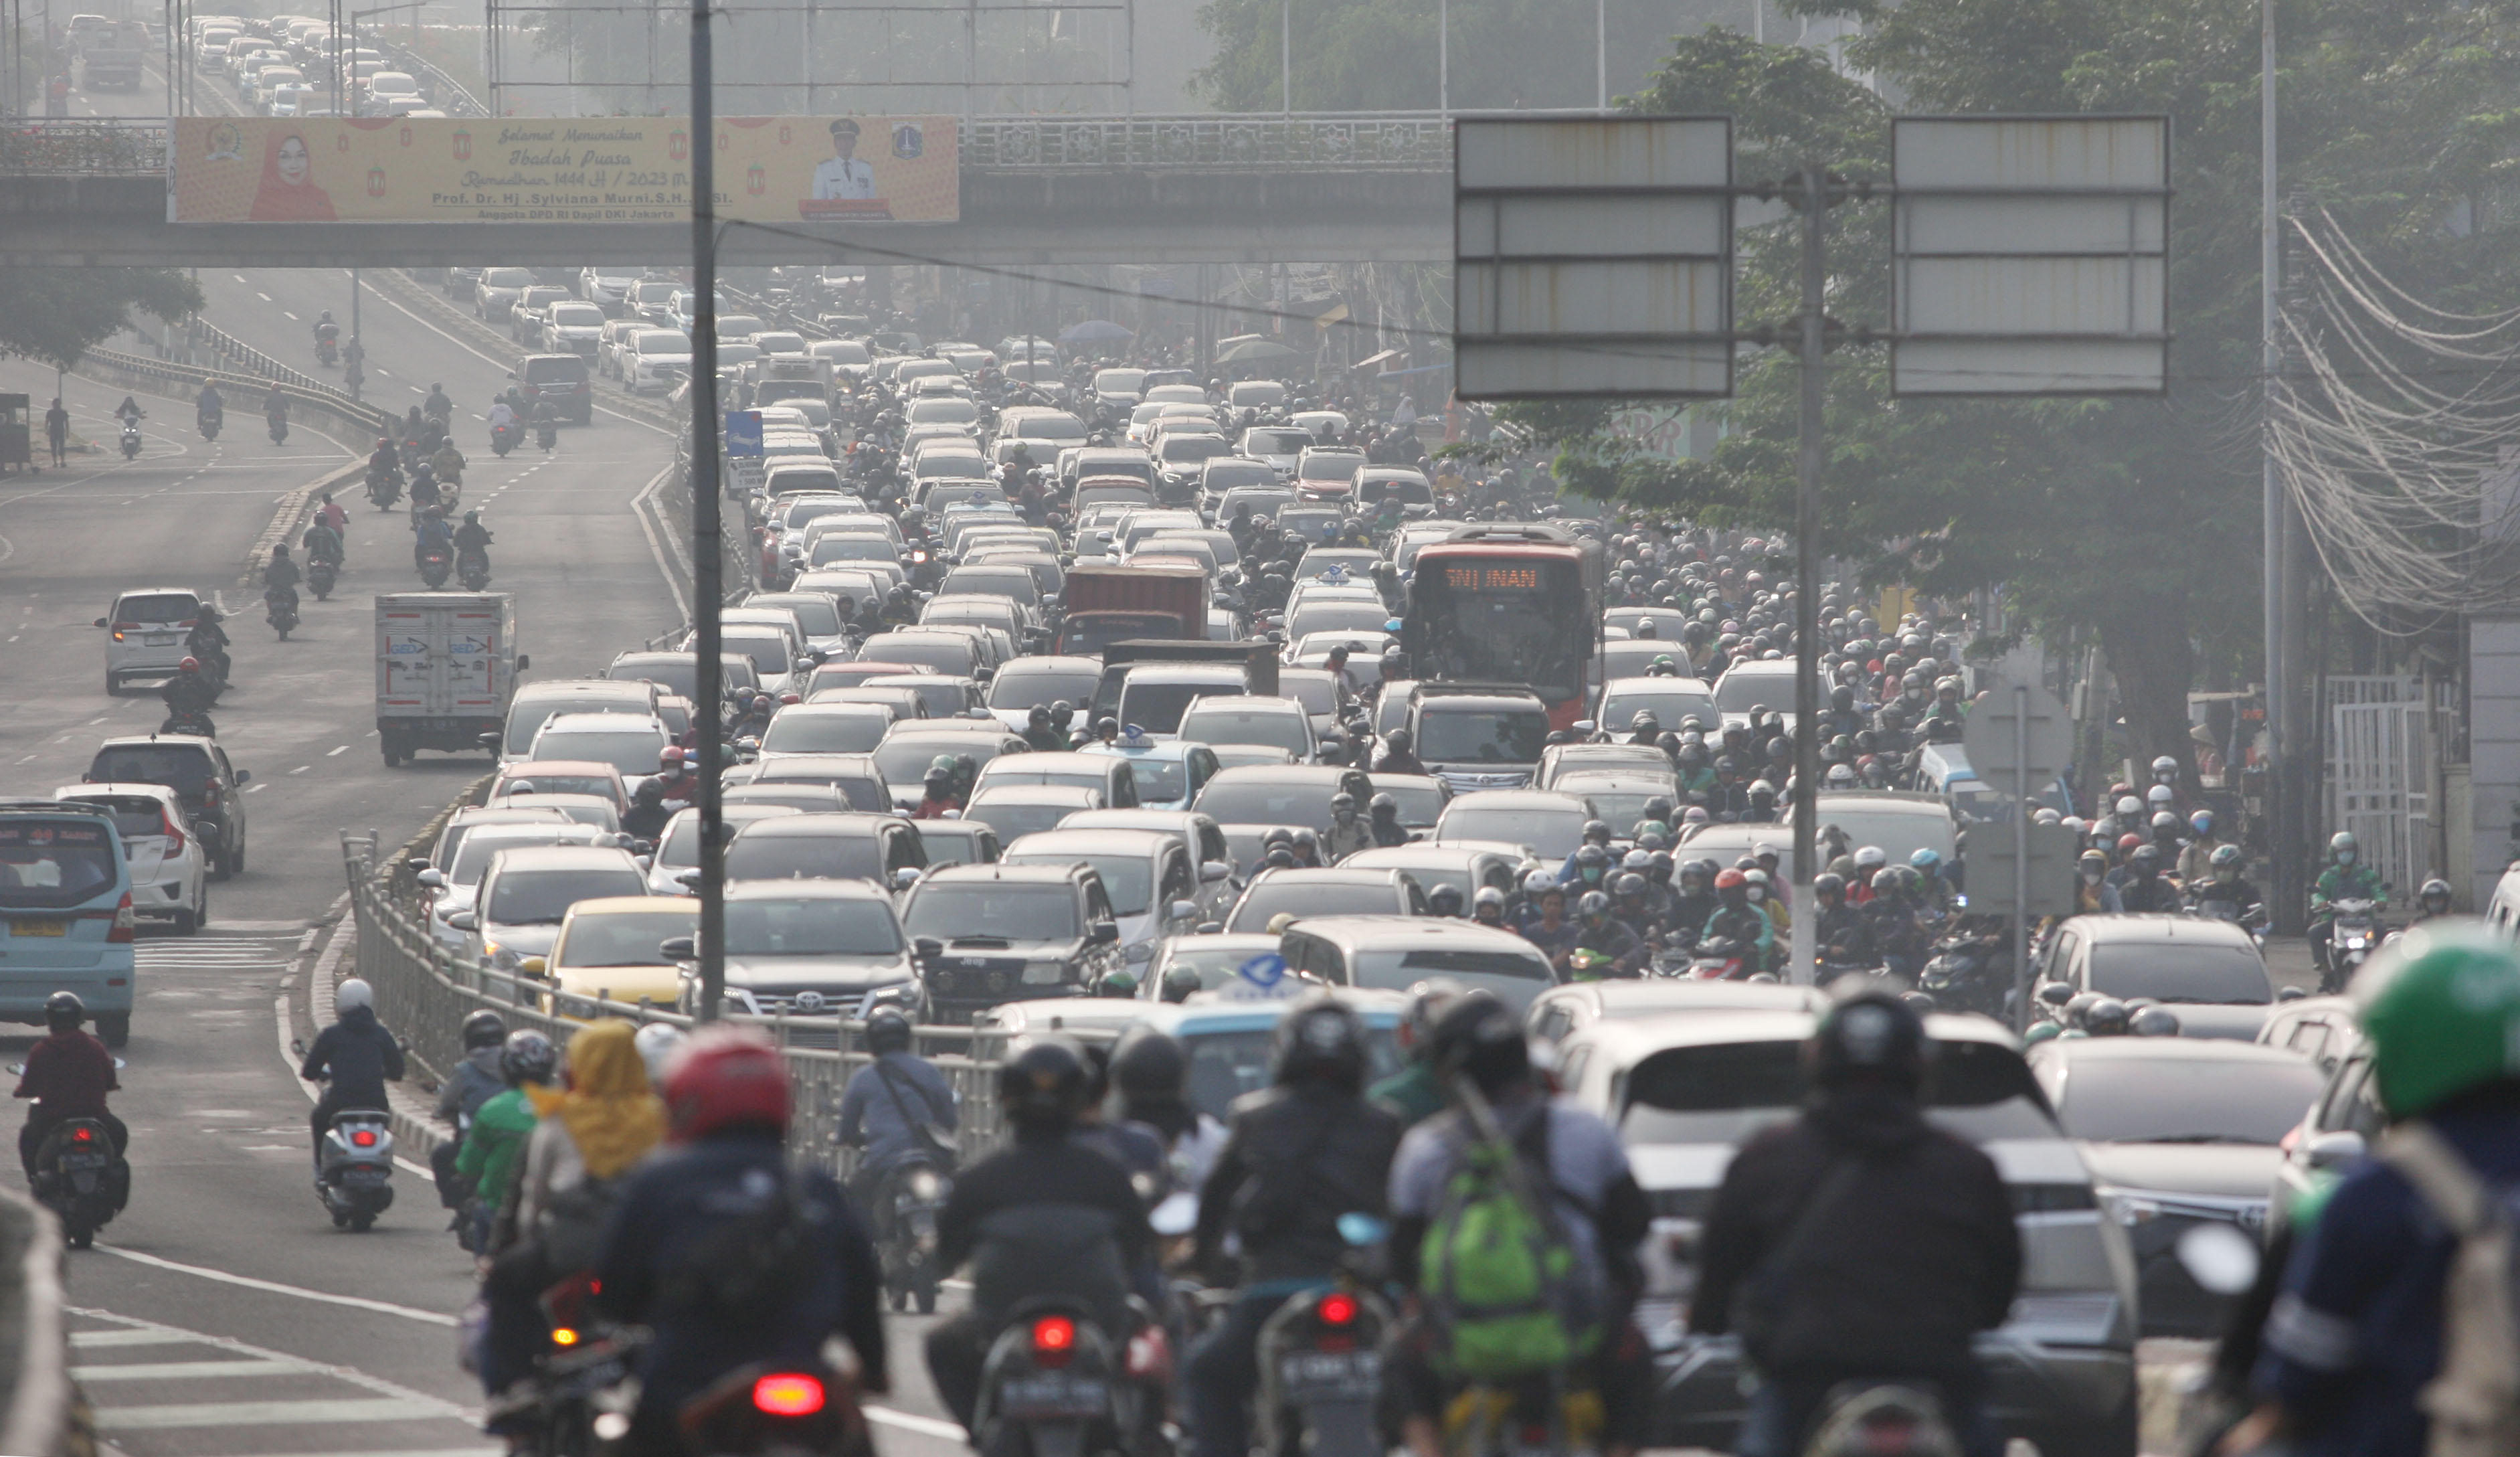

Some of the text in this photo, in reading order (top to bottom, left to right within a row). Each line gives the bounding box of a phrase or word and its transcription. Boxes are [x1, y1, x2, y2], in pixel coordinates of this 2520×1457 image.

[498, 126, 642, 145] Selamat Menunaikan
[580, 150, 632, 167] Puasa
[460, 171, 551, 187] Ramadhan
[555, 171, 585, 187] 1444
[626, 171, 667, 186] 2023
[432, 193, 468, 203] Prof.
[476, 193, 497, 203] Dr.
[503, 193, 519, 206] Hj
[478, 209, 674, 221] Anggota DPD RI Dapil DKI Jakarta
[960, 957, 986, 968] Jeep
